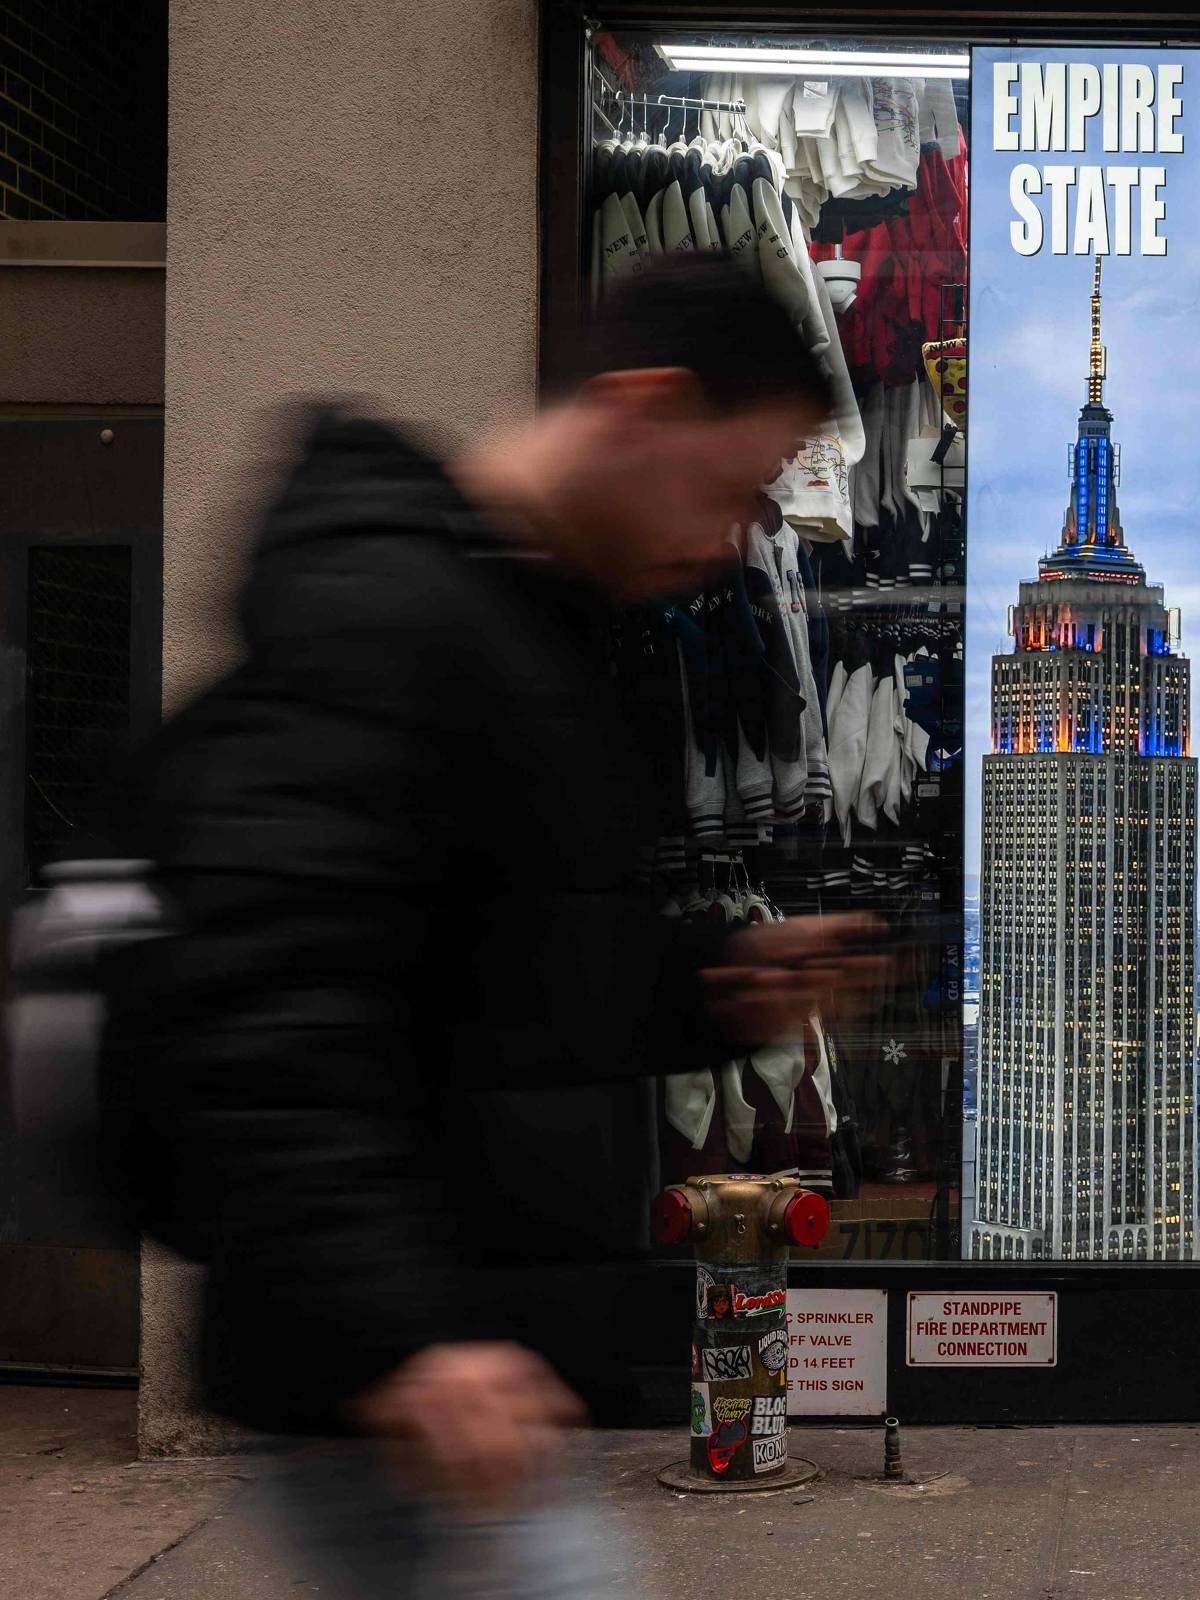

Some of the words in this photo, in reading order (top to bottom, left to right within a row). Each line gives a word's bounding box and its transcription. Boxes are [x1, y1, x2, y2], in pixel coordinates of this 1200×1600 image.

[993, 63, 1184, 153] EMPIRE
[1010, 164, 1167, 256] STATE
[943, 1302, 1022, 1316] STANDPIPE
[797, 1313, 874, 1324] SPRINKLER
[916, 1322, 947, 1335] FIRE
[952, 1322, 1047, 1336] DEPARTMENT
[810, 1336, 852, 1346] VALVE
[937, 1342, 1027, 1356] CONNECTION
[803, 1358, 817, 1368] 14
[821, 1358, 855, 1368] FEET
[798, 1381, 827, 1391] THIS
[832, 1381, 864, 1391] SIGN
